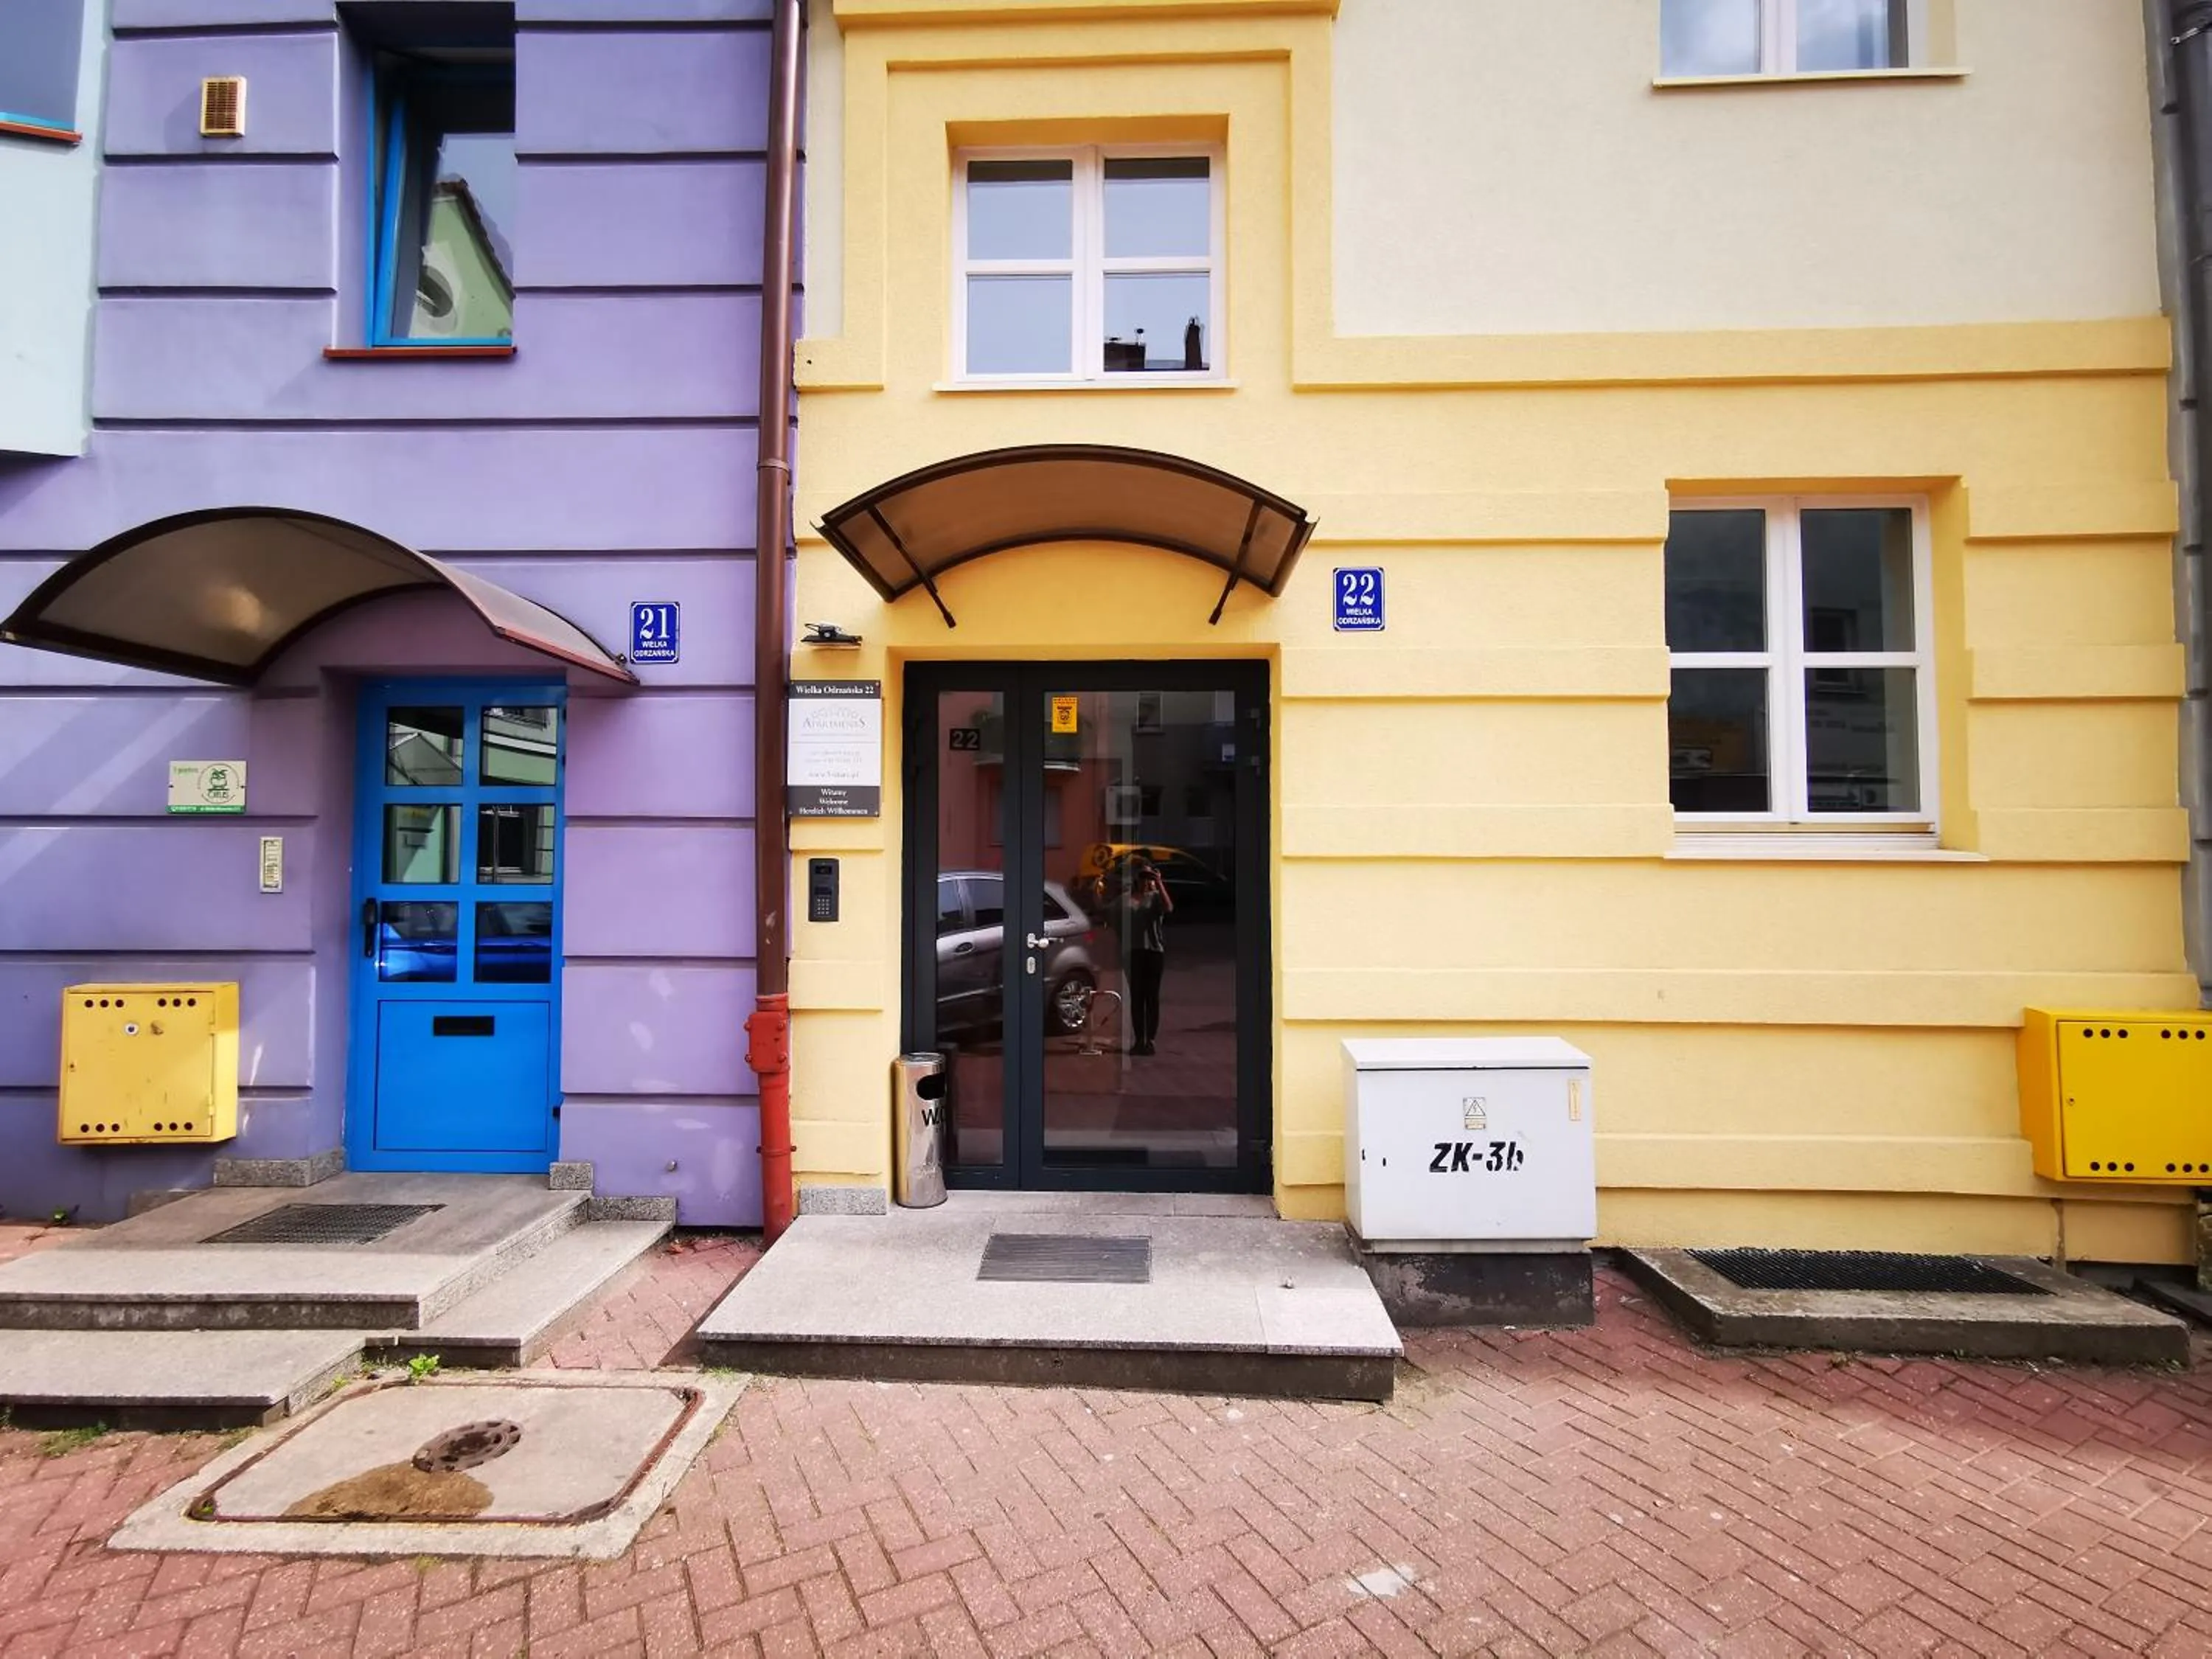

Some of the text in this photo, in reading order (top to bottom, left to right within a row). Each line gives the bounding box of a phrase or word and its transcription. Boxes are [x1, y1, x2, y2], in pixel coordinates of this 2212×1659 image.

[1343, 573, 1374, 605] 22
[1346, 608, 1373, 616] WIELKA
[639, 608, 669, 639] 21
[796, 685, 822, 694] Wielka
[865, 686, 874, 694] 22
[952, 731, 978, 748] 22
